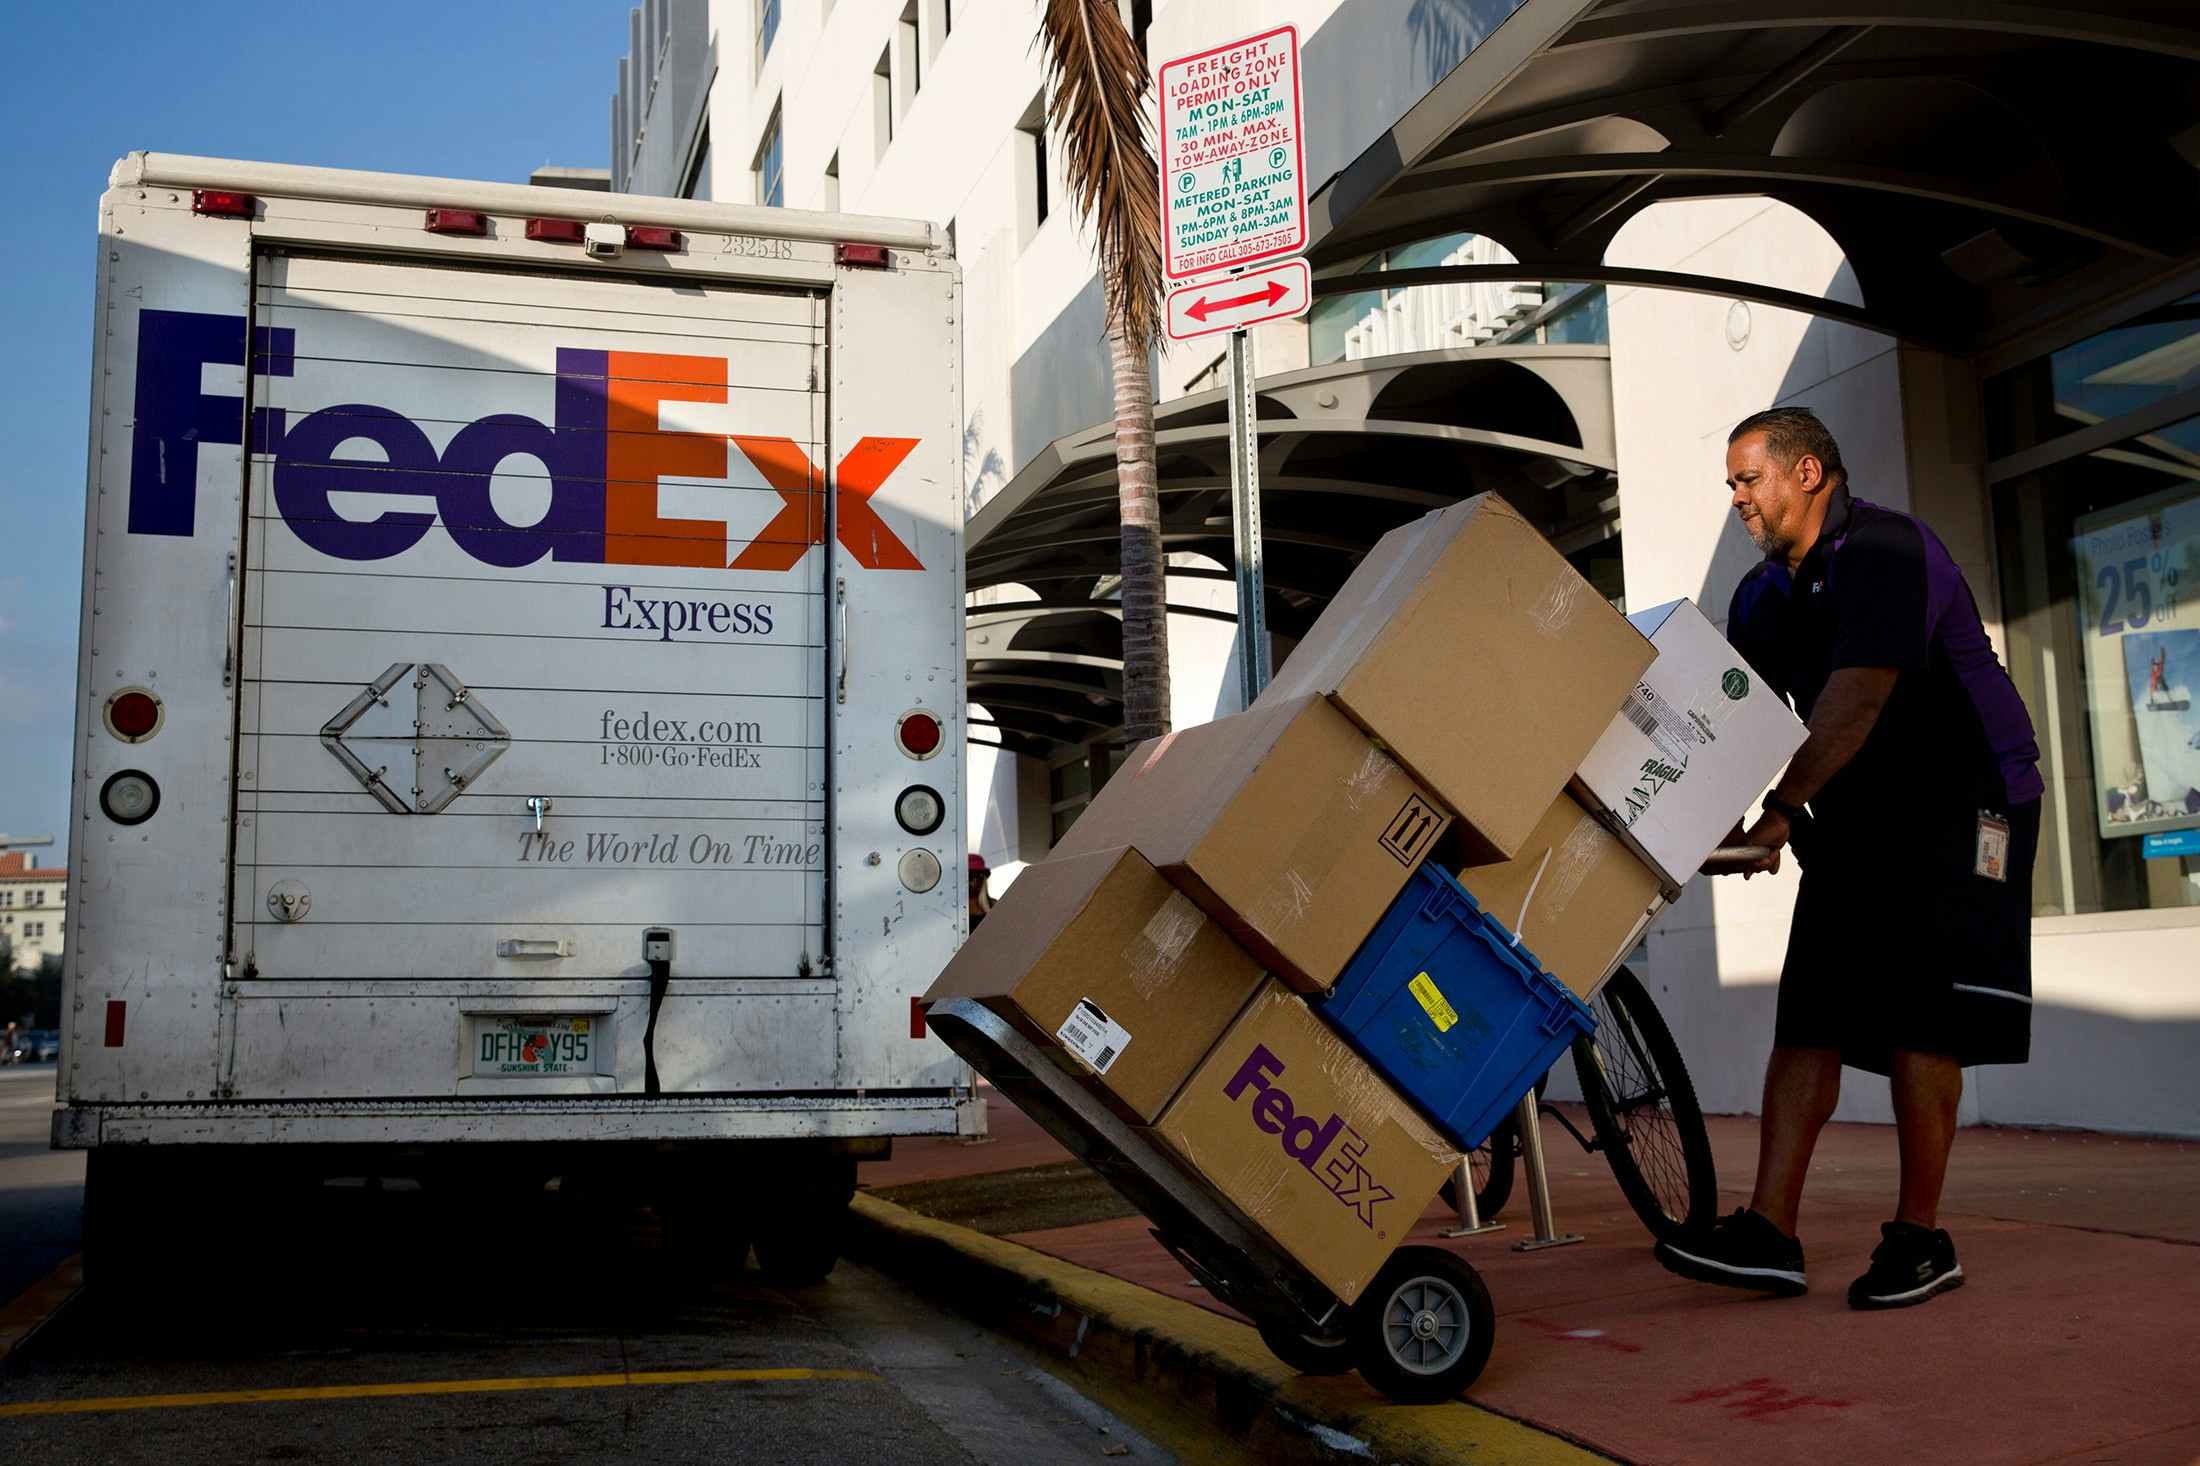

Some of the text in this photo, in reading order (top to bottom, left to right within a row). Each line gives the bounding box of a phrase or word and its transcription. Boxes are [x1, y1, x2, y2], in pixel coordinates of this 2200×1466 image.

[1171, 53, 1287, 97] LOADING ZONE
[1187, 43, 1268, 77] FREIGHT
[1177, 70, 1280, 110] PERMIT ONLY
[1189, 88, 1270, 122] MON-SAT
[1176, 125, 1198, 141] 7AM
[1208, 117, 1228, 132] 1PM
[1231, 114, 1238, 126] &
[1240, 100, 1285, 123] 6PM-8PM
[1180, 118, 1281, 154] 30 MIN. MAX.
[1174, 128, 1289, 167] TOW-AWAY-ZONE
[1174, 169, 1293, 209] METERED PARKING
[1197, 189, 1271, 217] MON-SAT
[1176, 196, 1293, 236] 1PM-6PM & 8PM-3AM
[1181, 212, 1289, 248] SUNDAY 9AM-3AM
[722, 235, 792, 260] 232548
[1179, 256, 1196, 270] FOR
[1196, 251, 1216, 266] INFO
[1218, 246, 1237, 262] CALL
[127, 308, 926, 571] FedEx
[601, 585, 773, 641] Express
[600, 710, 762, 744] fedex.com
[1640, 758, 1685, 783] FRAGILE
[518, 833, 821, 866] The World On Time
[501, 1063, 568, 1073] SUNSHINE STATE
[1223, 1043, 1394, 1229] FedEx
